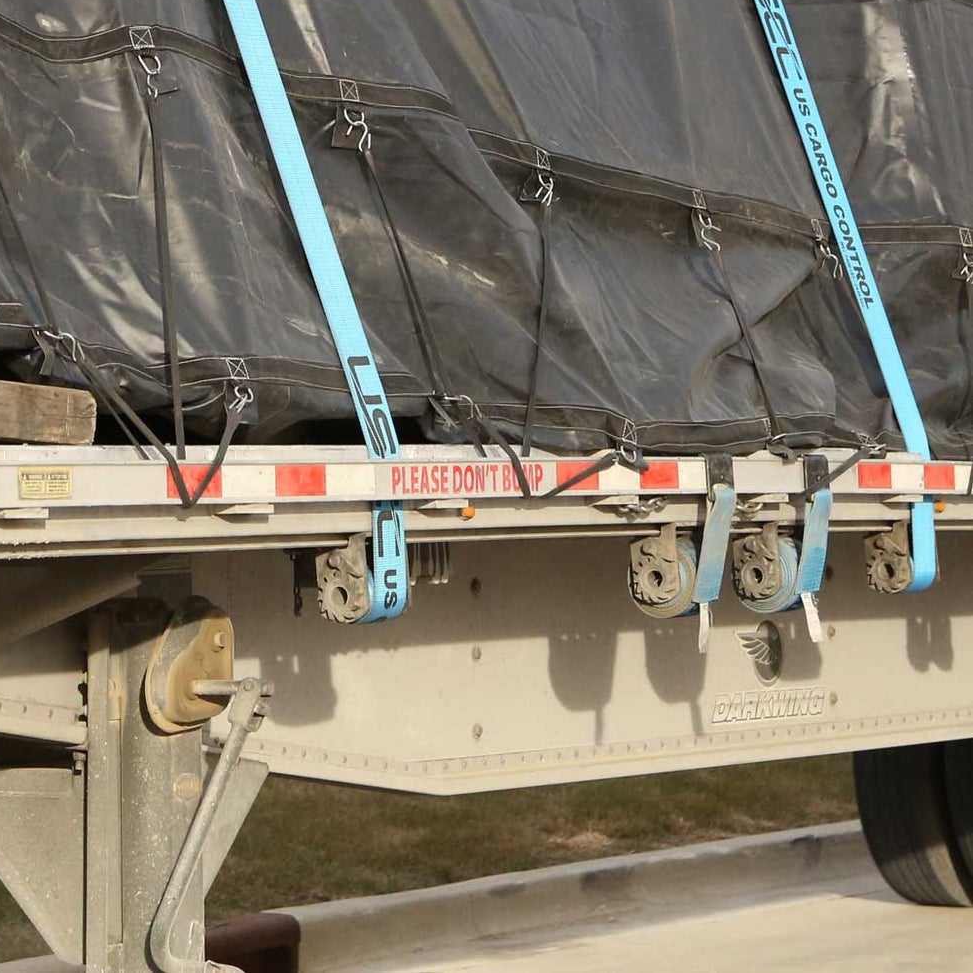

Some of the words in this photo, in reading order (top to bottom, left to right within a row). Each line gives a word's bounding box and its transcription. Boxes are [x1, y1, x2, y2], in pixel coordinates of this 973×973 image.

[793, 87, 811, 117] US
[805, 122, 838, 199] CARGO
[833, 204, 875, 310] CONTROL
[392, 465, 449, 495] PLEASE
[452, 465, 499, 494] DON'T
[384, 569, 398, 609] US
[711, 687, 826, 724] DARKWING
